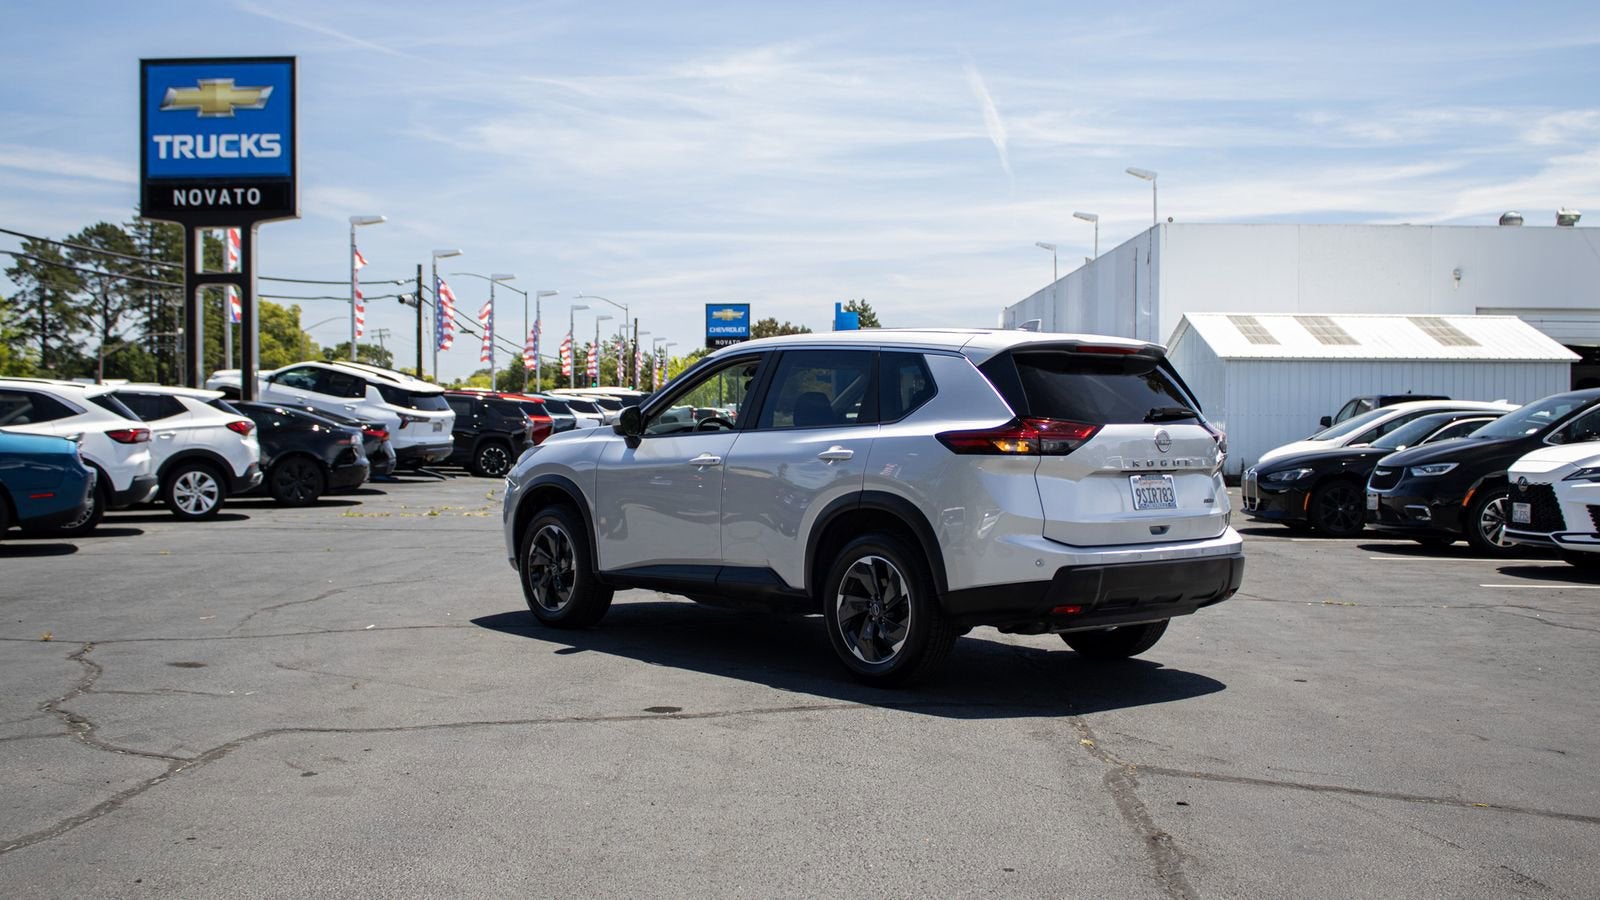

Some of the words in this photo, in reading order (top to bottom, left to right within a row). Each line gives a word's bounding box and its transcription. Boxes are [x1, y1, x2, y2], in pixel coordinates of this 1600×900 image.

[152, 133, 281, 159] TRUCKS
[173, 188, 261, 206] NOVATO
[1136, 487, 1174, 504] 9SIR783
